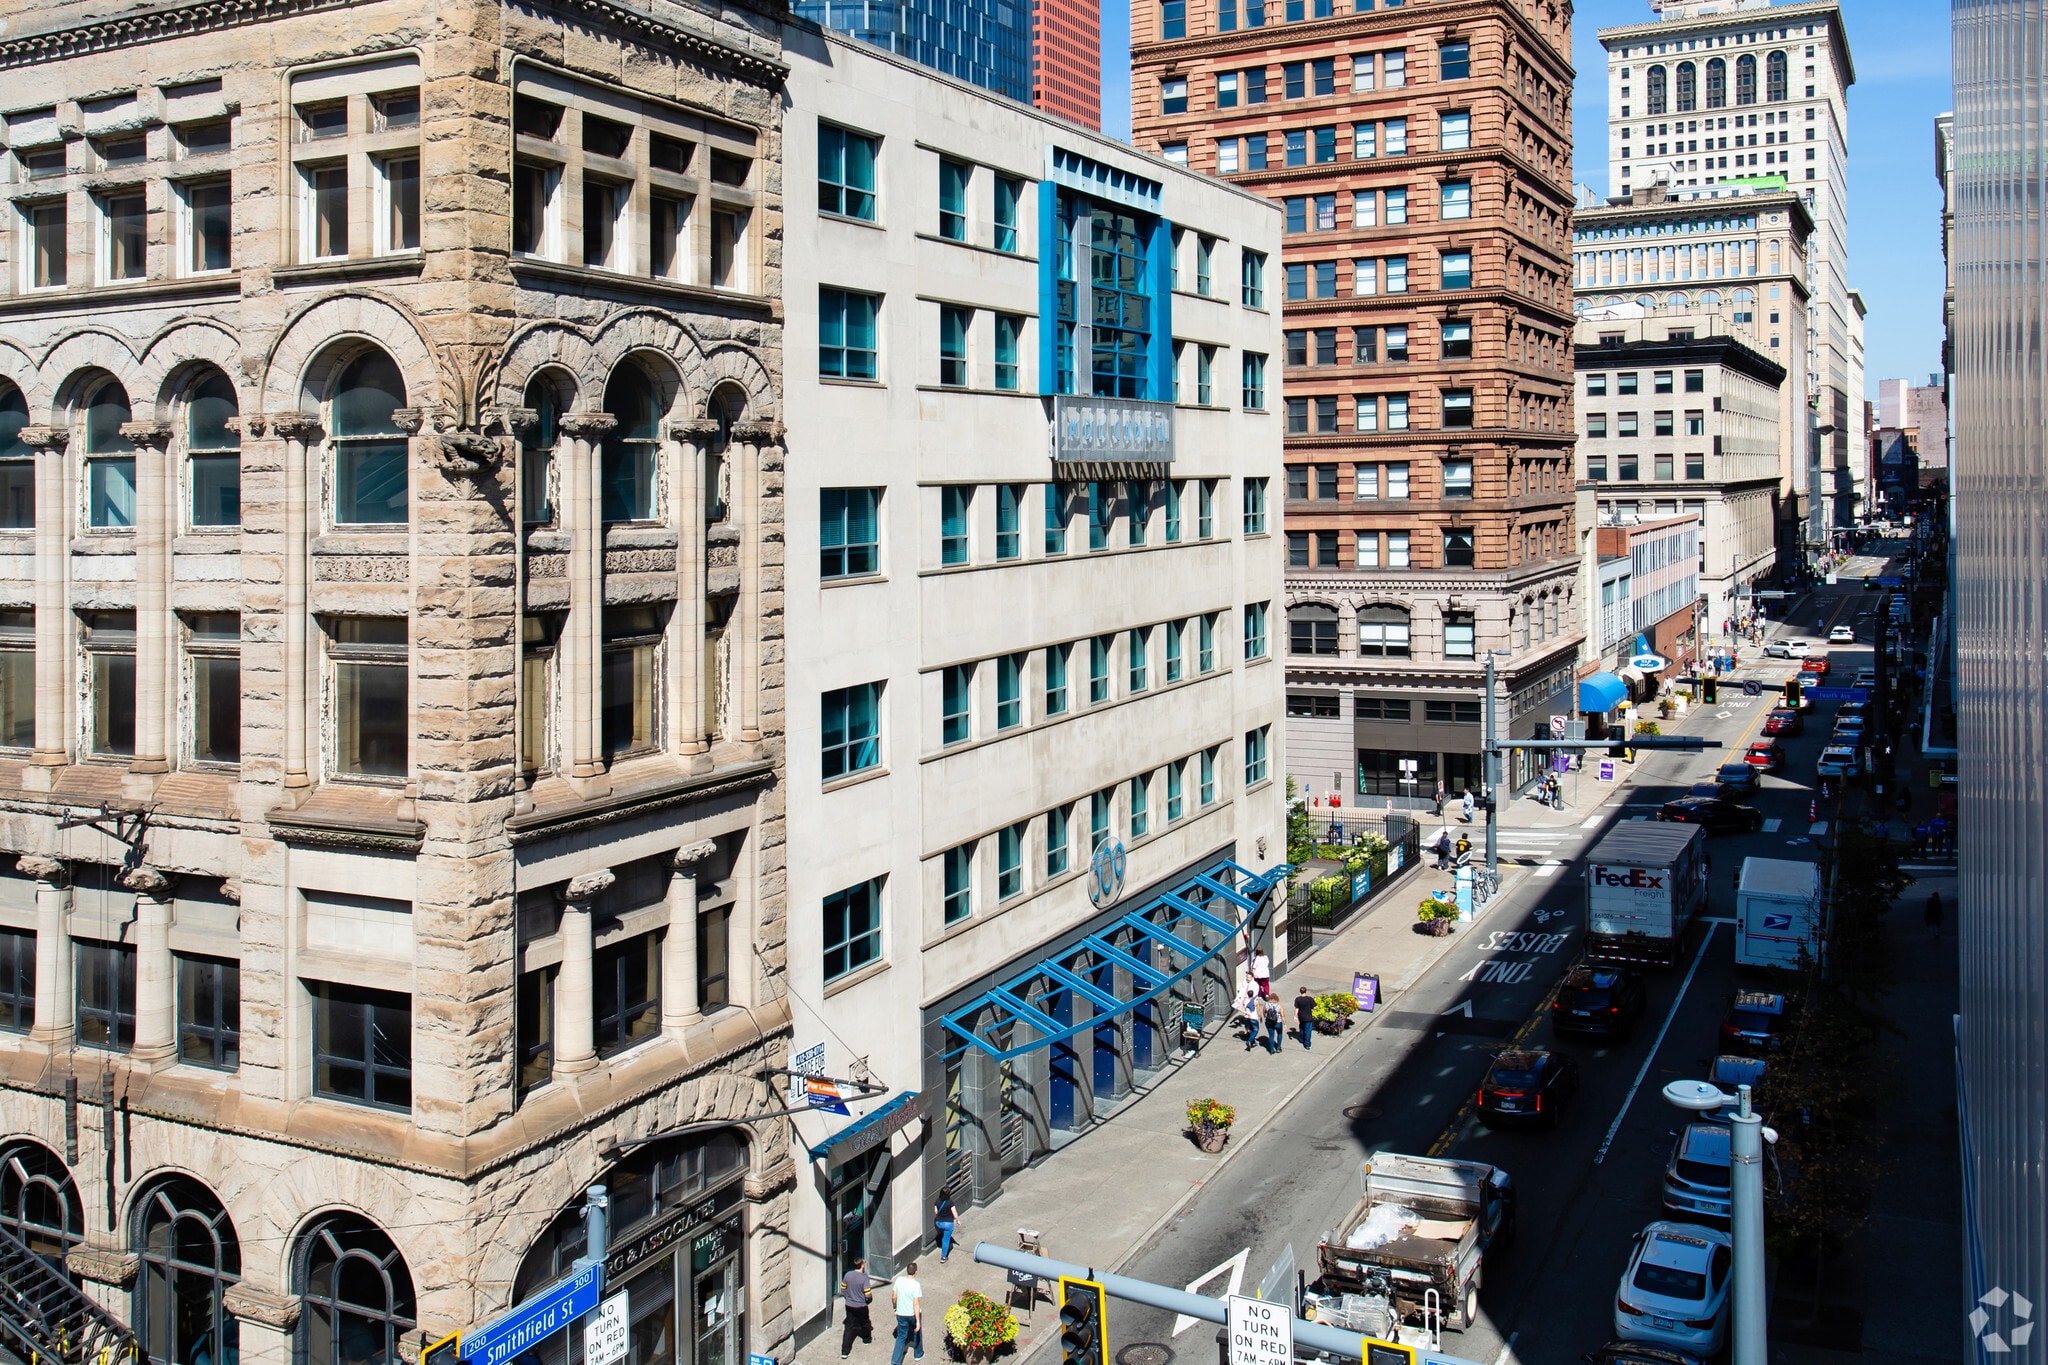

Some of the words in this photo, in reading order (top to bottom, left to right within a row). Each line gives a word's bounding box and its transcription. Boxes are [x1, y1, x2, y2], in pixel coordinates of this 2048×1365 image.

[1093, 841, 1125, 902] 309
[1595, 867, 1664, 890] FedEx
[1634, 889, 1665, 899] Freight
[1477, 931, 1569, 954] BUSES
[1458, 959, 1533, 984] ONLY
[627, 1248, 638, 1265] &
[639, 1199, 715, 1257] ASSOCIATES
[711, 1237, 723, 1251] AT
[708, 1245, 726, 1264] LAW
[574, 1273, 590, 1290] 300
[598, 1303, 615, 1319] NO
[1248, 1305, 1271, 1320] NO
[487, 1309, 555, 1365] Smithfield
[561, 1298, 574, 1320] St
[594, 1314, 620, 1337] TURN
[1242, 1319, 1278, 1338] TURN
[468, 1335, 487, 1353] 200
[589, 1339, 602, 1355] ON
[606, 1326, 625, 1346] RED
[611, 1340, 625, 1356] 6PM
[1235, 1334, 1253, 1348] ON
[1260, 1339, 1286, 1355] RED
[1237, 1350, 1257, 1365] 7AM
